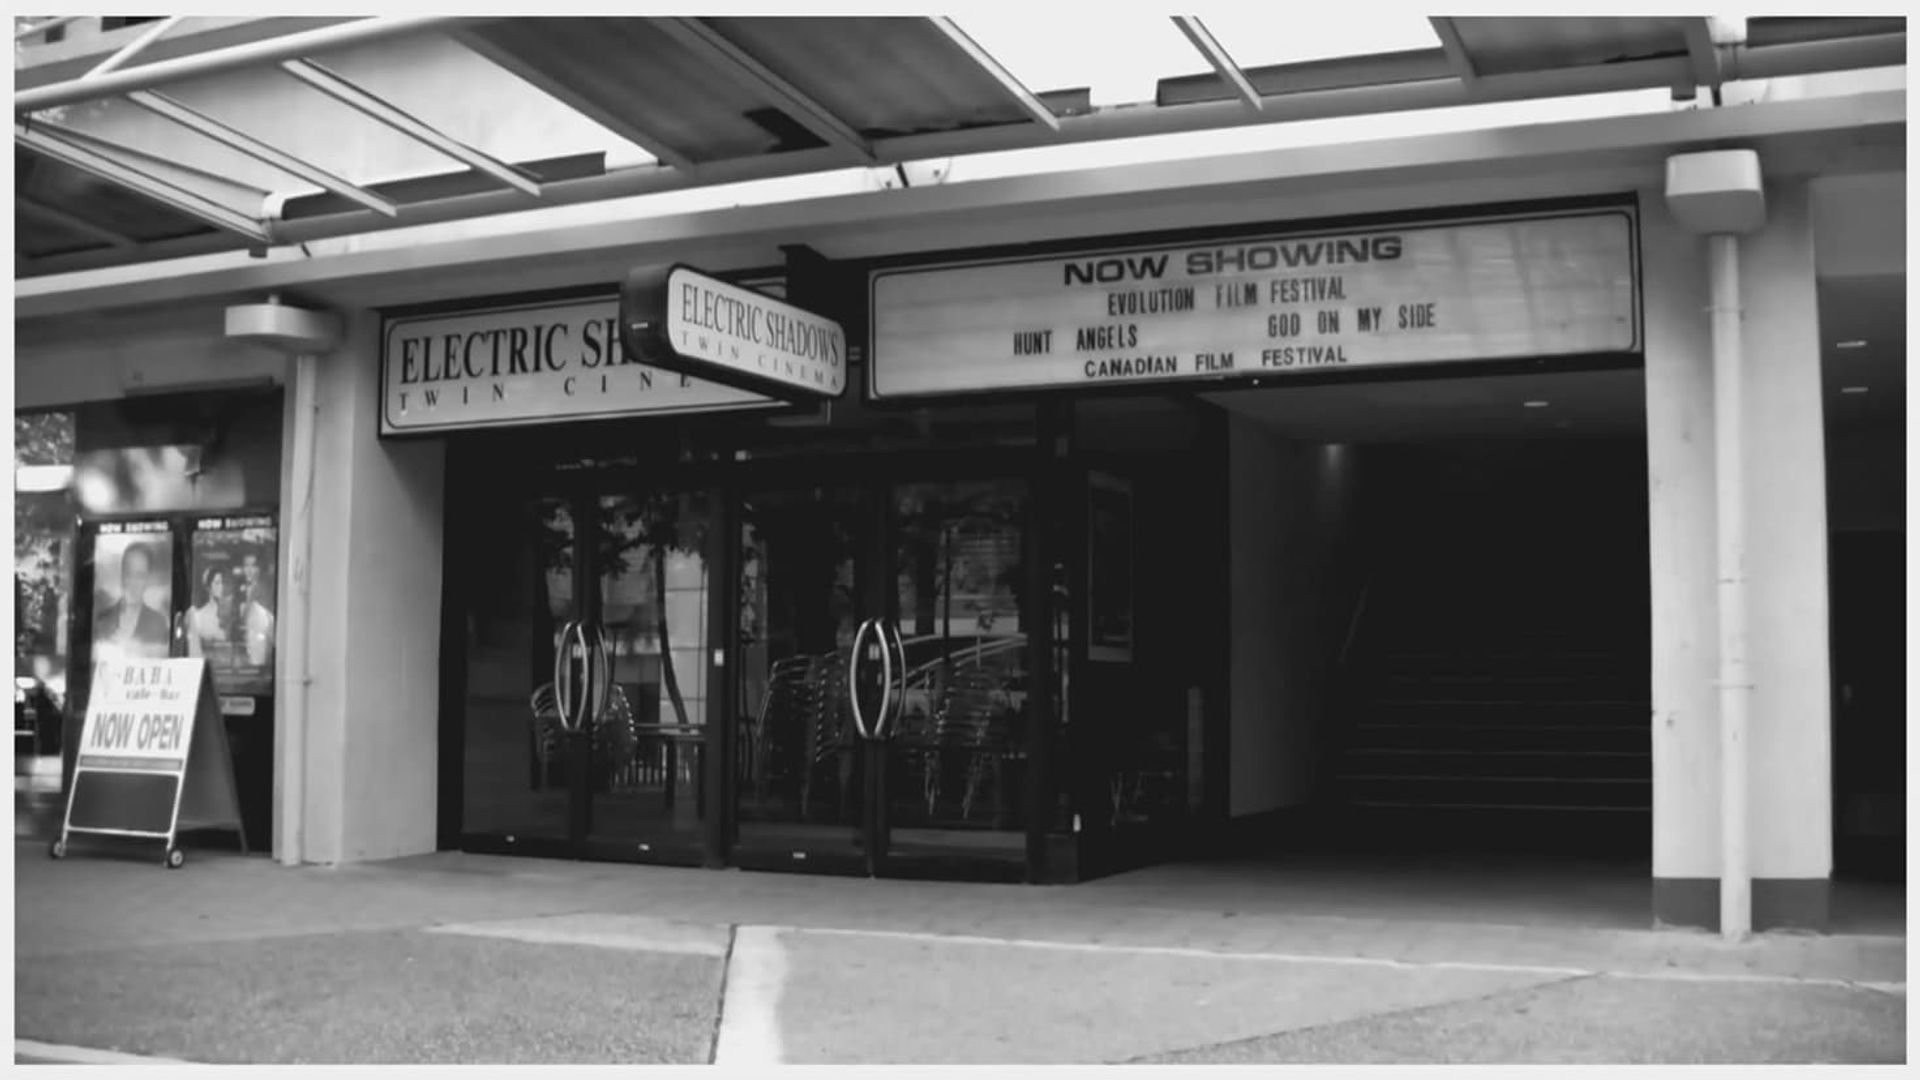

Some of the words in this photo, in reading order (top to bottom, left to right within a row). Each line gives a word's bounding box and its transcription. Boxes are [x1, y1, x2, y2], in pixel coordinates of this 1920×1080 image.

[1063, 254, 1169, 286] NOW
[1186, 236, 1403, 276] SHOWING
[1108, 286, 1195, 316] EVOLUTION
[1215, 283, 1258, 309] FILM
[1270, 276, 1347, 304] FESTIVAL
[681, 282, 763, 345] ELECTRIC
[766, 309, 839, 367] SHADOWS
[1013, 329, 1052, 355] HUNT
[1076, 323, 1138, 351] ANGELS
[1268, 313, 1301, 338] GOD
[1318, 310, 1340, 335] ON
[1358, 306, 1382, 332] MY
[1399, 303, 1436, 329] SIDE
[400, 322, 569, 385] ELECTRIC
[682, 330, 739, 360] TWIN
[757, 354, 838, 389] CINEMA
[1084, 355, 1178, 378] CANADIAN
[1195, 351, 1235, 372] FILM
[1261, 345, 1348, 367] FESTIVAL
[399, 383, 504, 411] TWIN
[91, 713, 136, 750] NOW
[137, 713, 184, 750] OPEN
